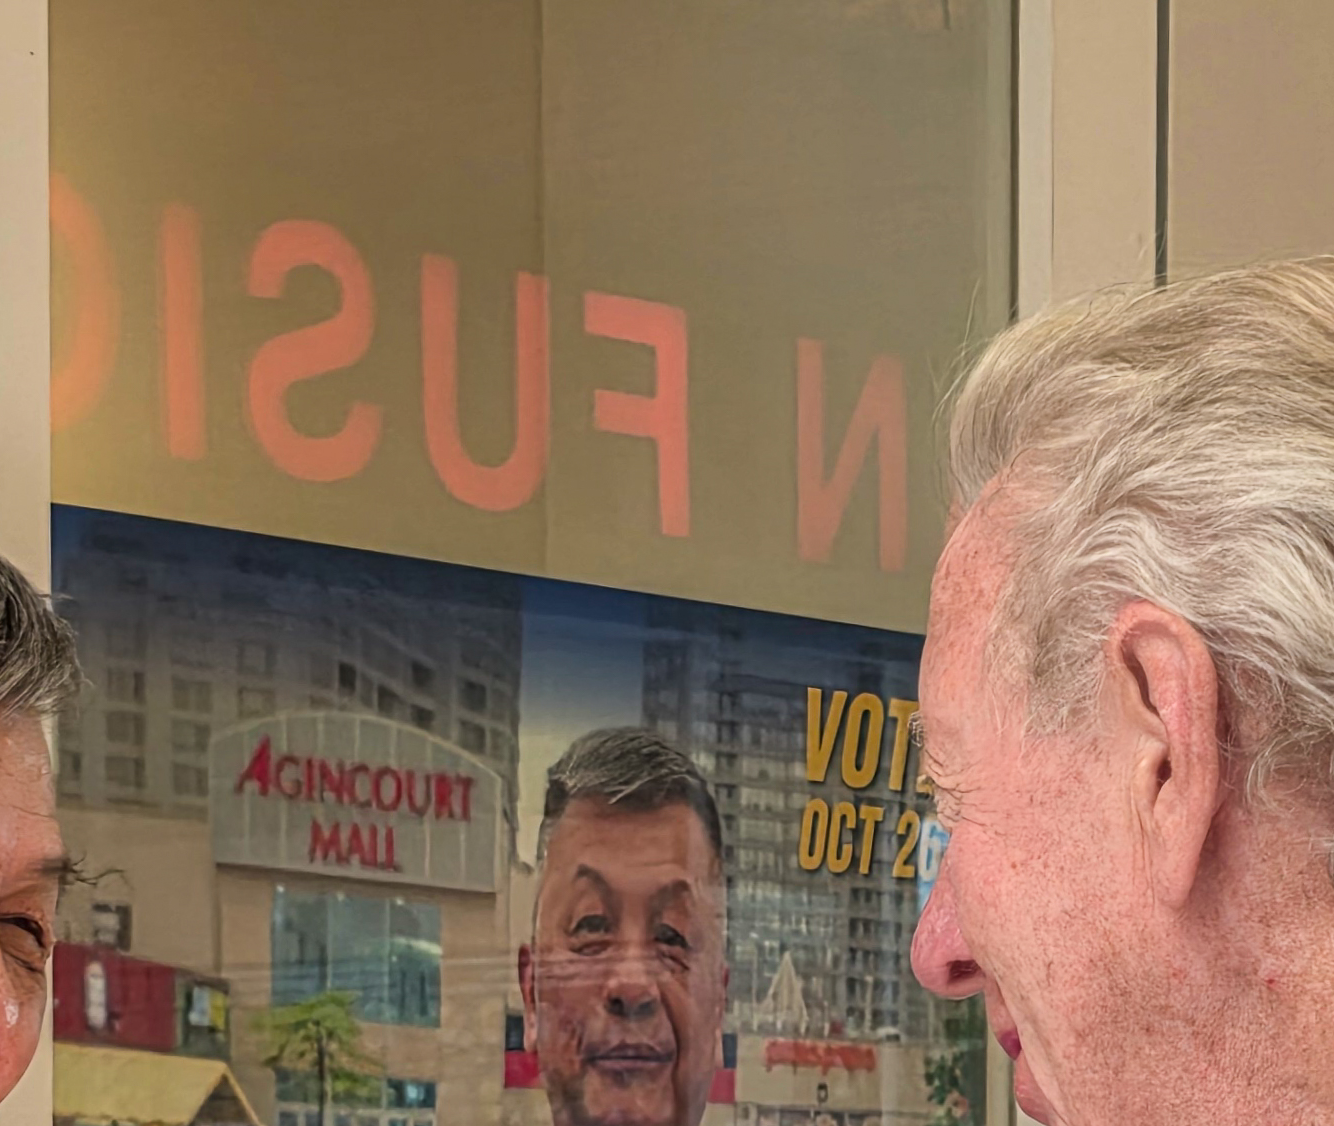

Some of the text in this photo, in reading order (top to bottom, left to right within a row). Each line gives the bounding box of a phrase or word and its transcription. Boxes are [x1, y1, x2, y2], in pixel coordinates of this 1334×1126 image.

[234, 733, 477, 823] AGINCOURT
[806, 686, 934, 796] VOT
[307, 818, 404, 873] MALL
[798, 797, 951, 883] OCT 26
